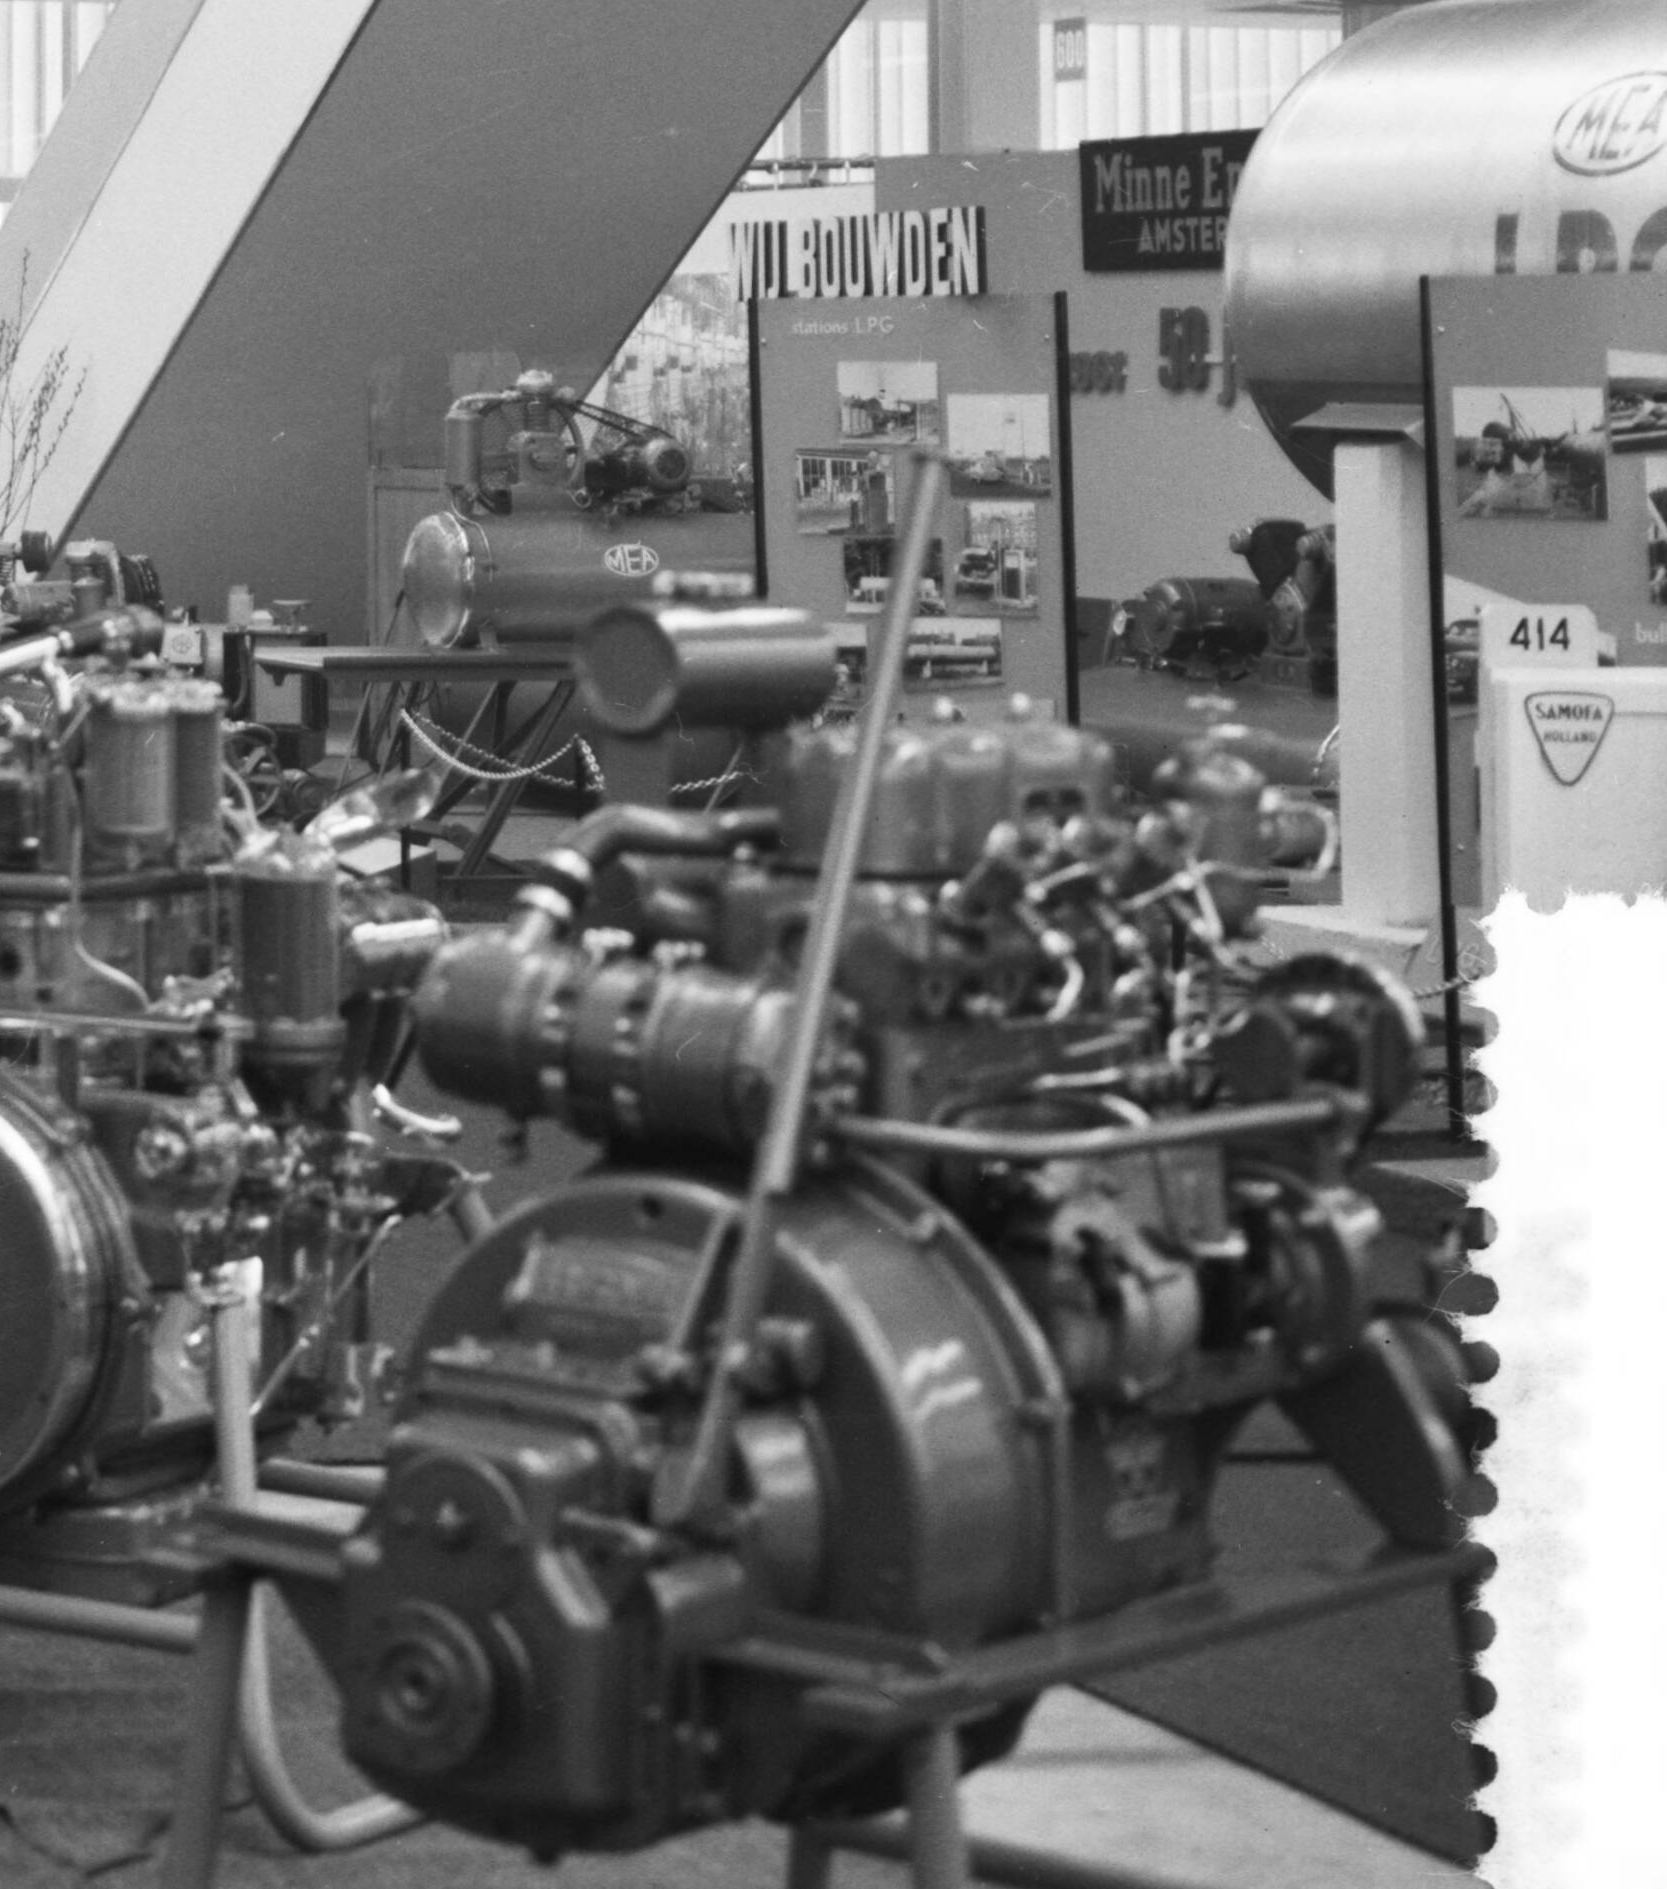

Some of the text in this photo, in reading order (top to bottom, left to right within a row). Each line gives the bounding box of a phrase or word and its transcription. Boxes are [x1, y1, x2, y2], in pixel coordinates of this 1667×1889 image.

[1094, 151, 1192, 212] Minne
[792, 318, 848, 335] stations
[1509, 616, 1570, 651] 414
[1534, 702, 1603, 721] SAMOFA
[1543, 730, 1597, 743] HOLLAND
